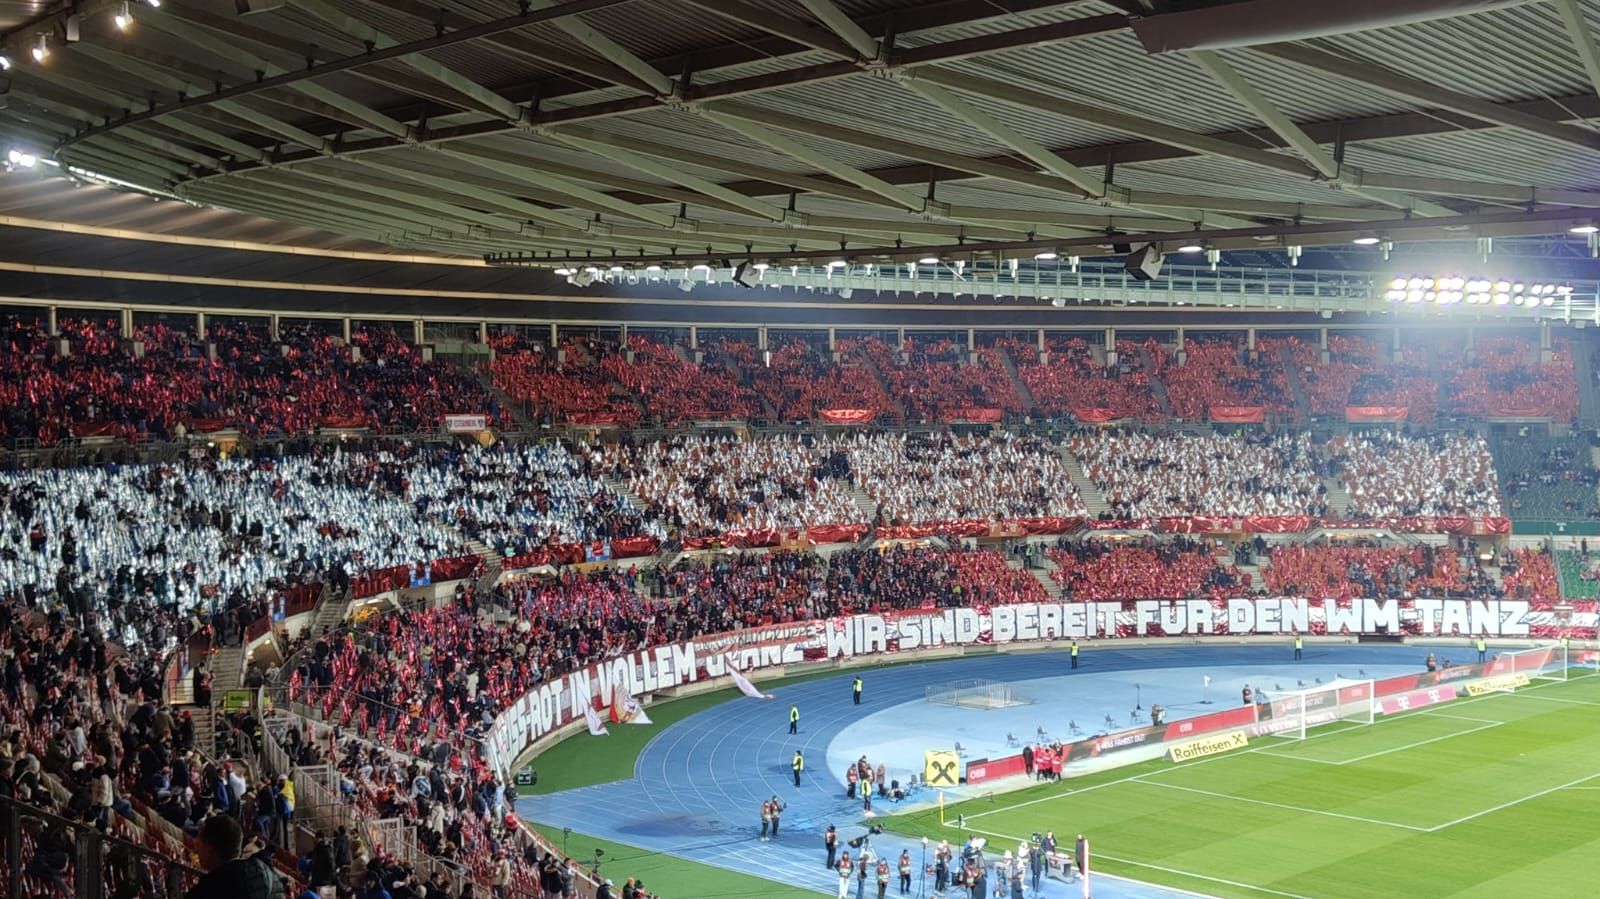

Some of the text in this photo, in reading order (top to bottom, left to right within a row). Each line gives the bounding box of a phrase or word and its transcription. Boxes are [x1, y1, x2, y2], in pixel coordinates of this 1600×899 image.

[569, 668, 592, 718] IN
[597, 641, 697, 706] VOLLEM
[826, 615, 886, 658] WIR
[898, 607, 980, 649] SIND
[992, 602, 1122, 641] BEREIT
[1136, 600, 1213, 634] FÜR
[1228, 599, 1308, 632] DEN
[1174, 740, 1231, 760] Raiffeisen
